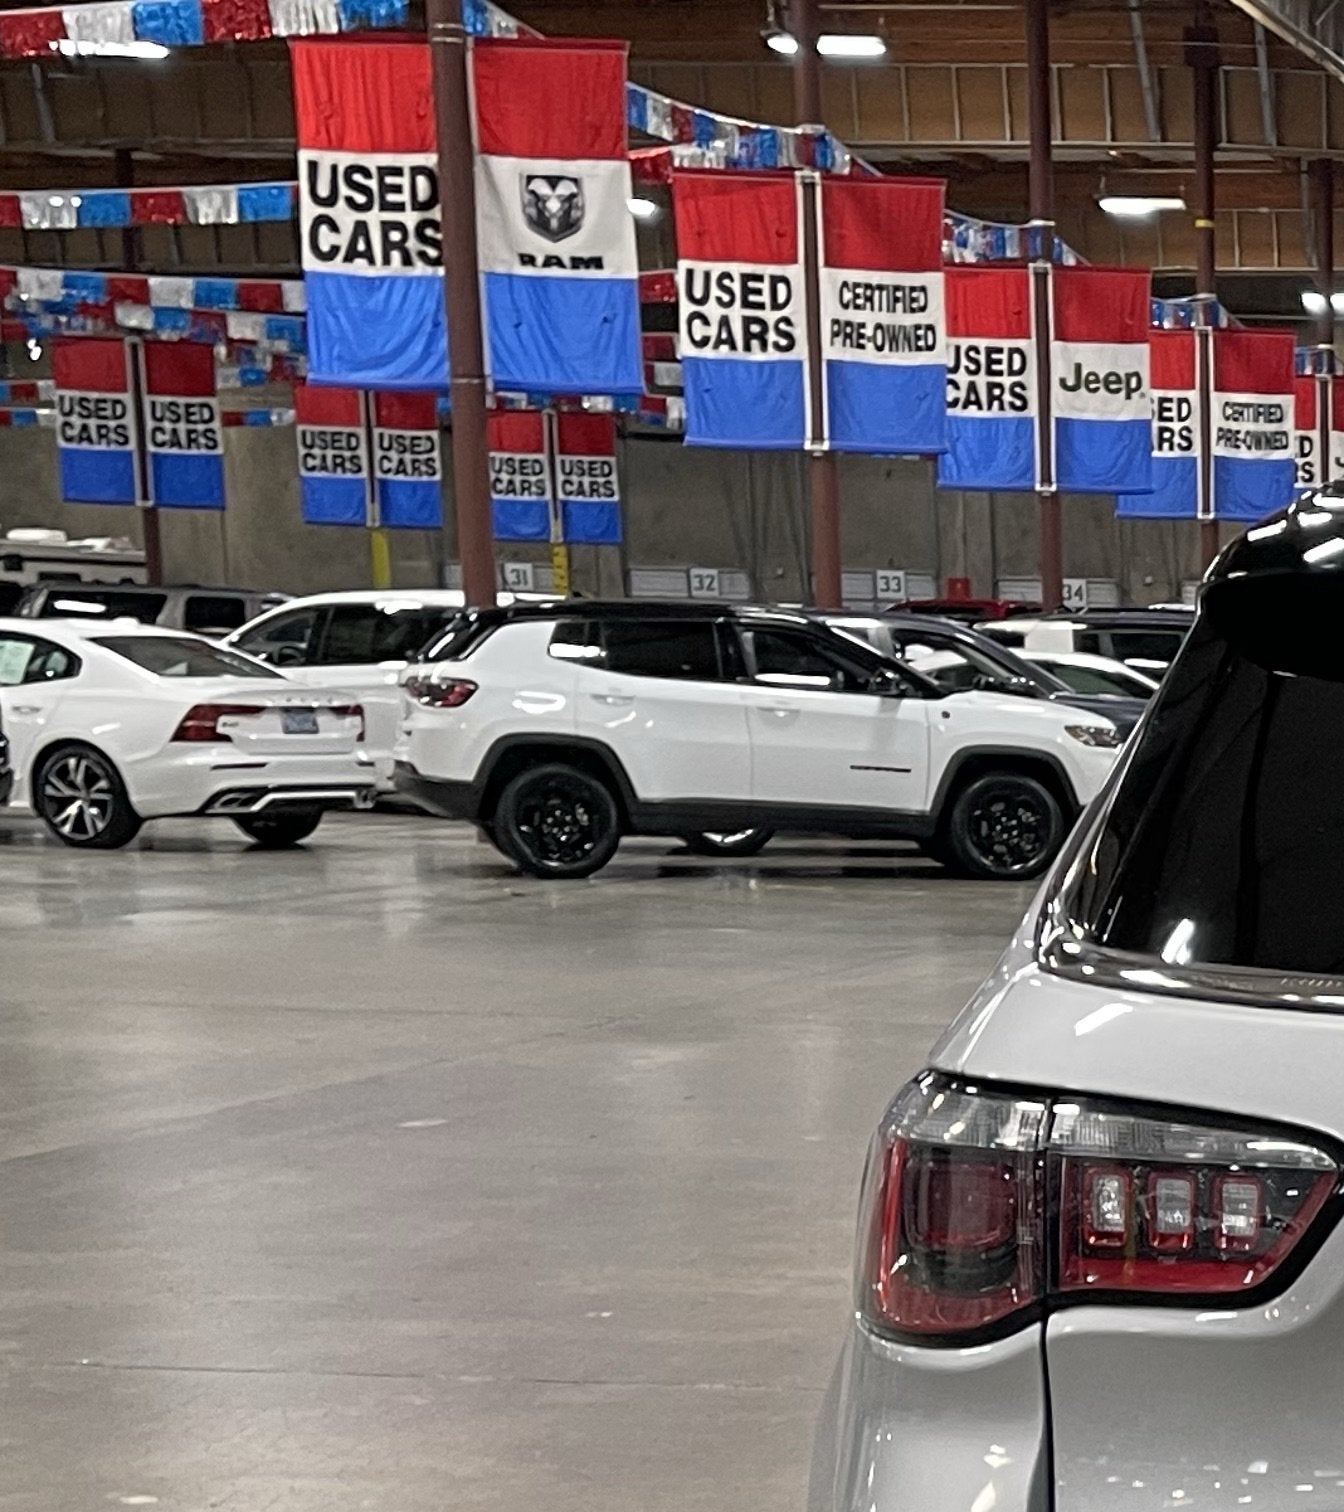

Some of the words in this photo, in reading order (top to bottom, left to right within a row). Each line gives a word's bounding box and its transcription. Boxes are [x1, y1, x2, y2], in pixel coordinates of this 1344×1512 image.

[308, 160, 440, 213] USED
[309, 214, 442, 267] CARS
[517, 253, 604, 270] RAM
[685, 268, 792, 311] USED
[839, 280, 928, 314] CERTIFIED
[686, 311, 796, 352] CARS
[830, 318, 936, 352] PRE-OWNED
[1059, 363, 1143, 400] Jeep
[58, 395, 127, 420] USED
[151, 400, 214, 424] USED
[61, 421, 129, 445] CARS
[151, 427, 218, 449] CARS
[302, 430, 360, 451] USED
[379, 432, 435, 455] USED
[303, 453, 362, 474] CARS
[379, 455, 437, 477] CARS
[491, 457, 544, 476] USED
[561, 459, 613, 478] USED
[492, 478, 546, 496] CARS
[561, 480, 615, 498] CARS
[510, 569, 528, 586] 31
[694, 574, 716, 592] 32
[879, 576, 901, 593] 33
[1062, 584, 1083, 601] 34
